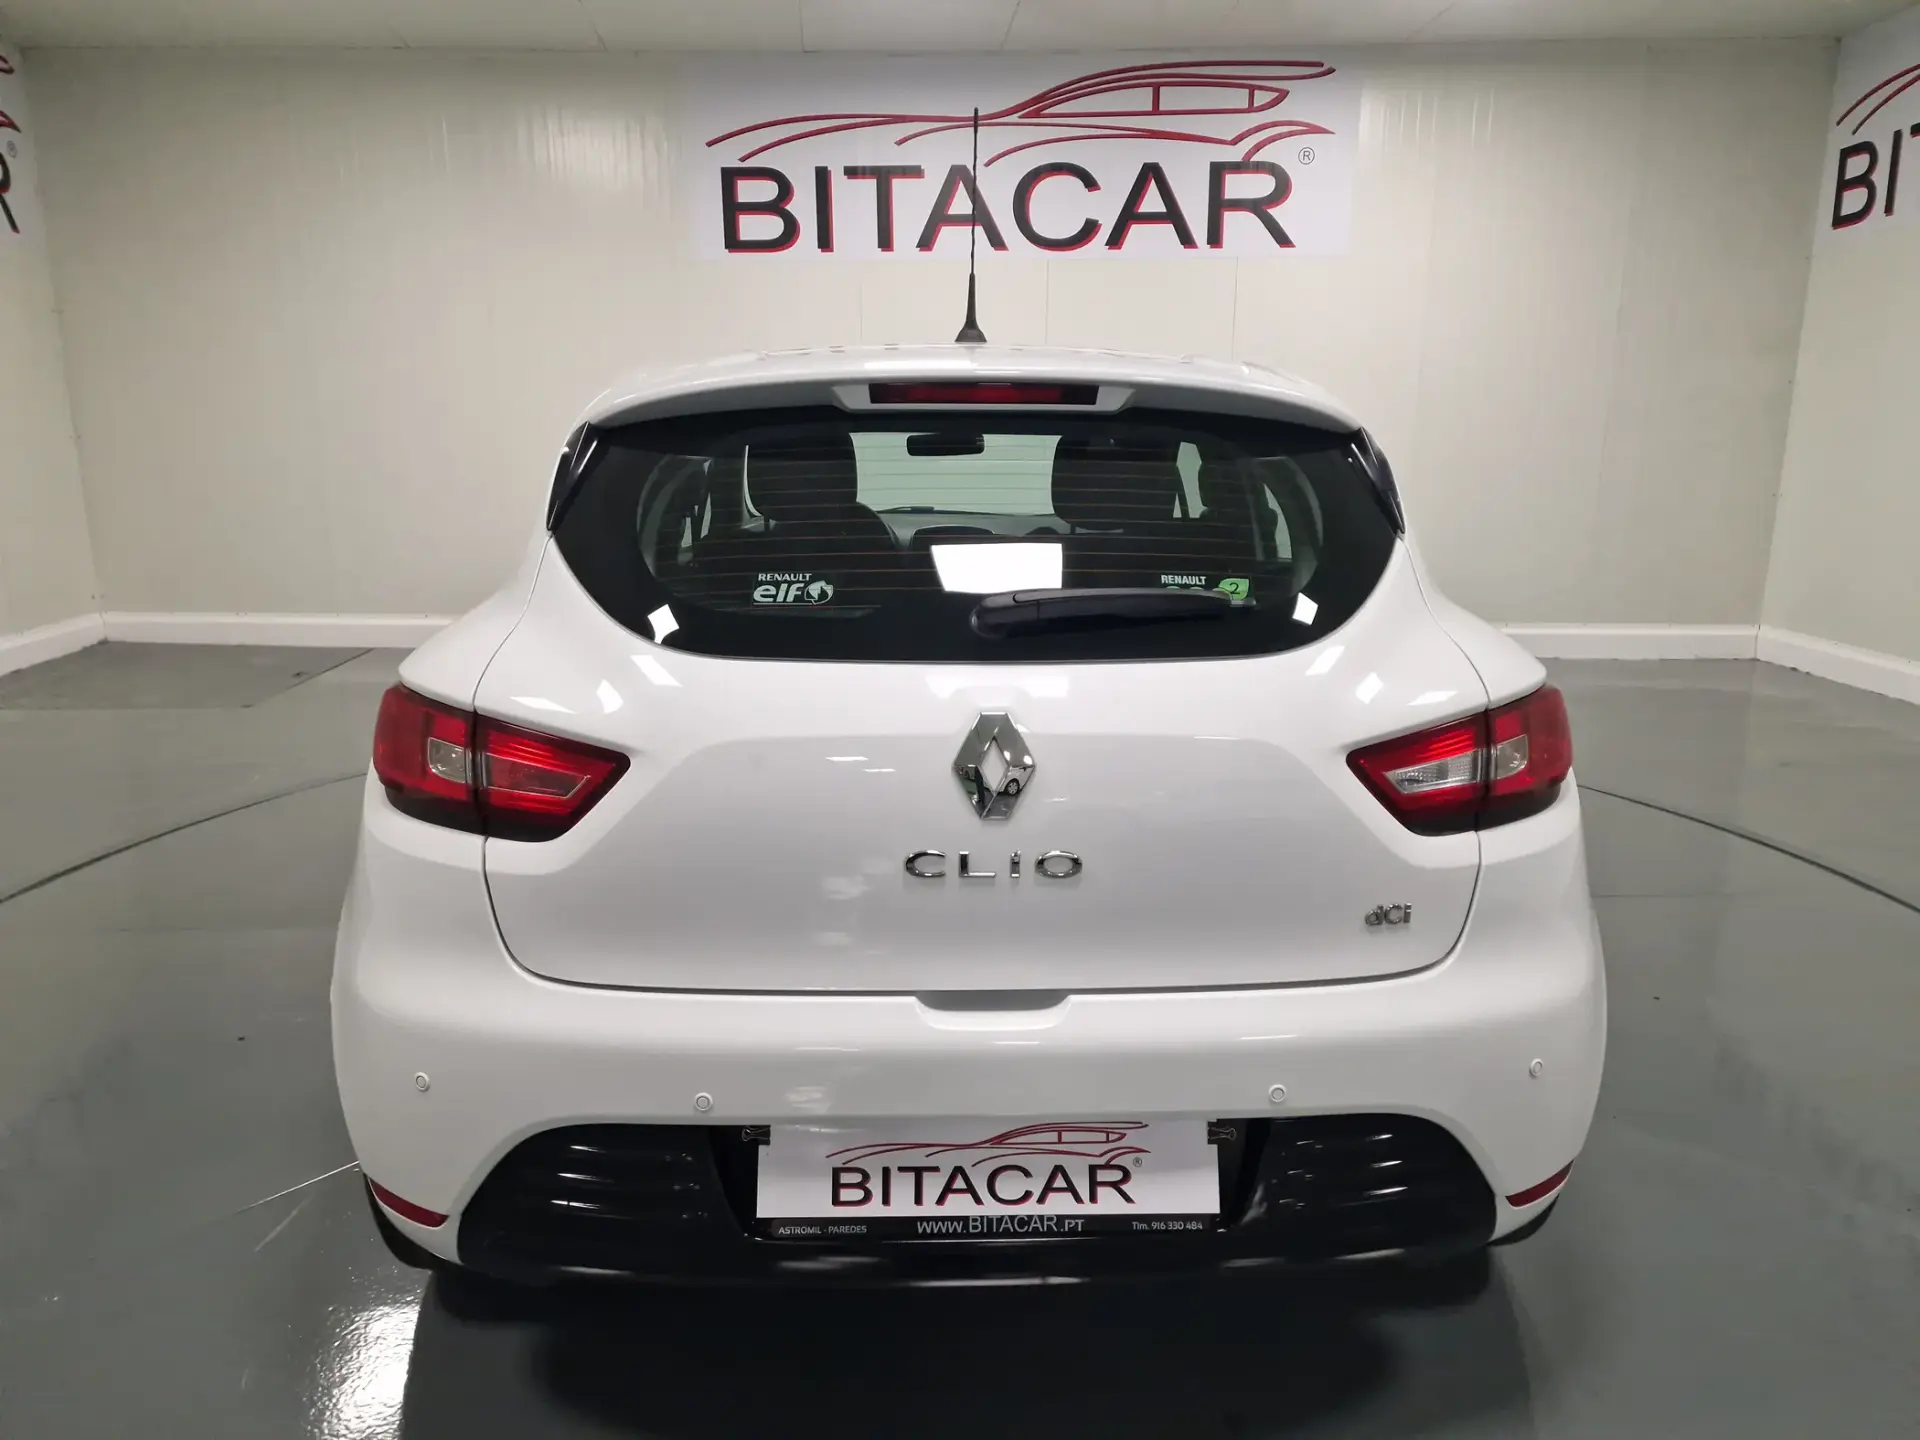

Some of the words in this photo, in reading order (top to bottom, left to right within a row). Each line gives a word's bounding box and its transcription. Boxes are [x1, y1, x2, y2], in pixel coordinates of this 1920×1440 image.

[721, 160, 1297, 253] BITACAR
[758, 573, 812, 581] RENAULT
[1161, 575, 1206, 585] RENAULT
[753, 583, 805, 603] elf
[1229, 582, 1240, 595] 2
[831, 1164, 1137, 1207] BITACAR
[778, 1226, 822, 1235] ASTROMIL
[828, 1225, 867, 1234] PAREDES
[1151, 1221, 1166, 1230] 916
[1167, 1221, 1184, 1230] 330
[1185, 1221, 1203, 1230] 484
